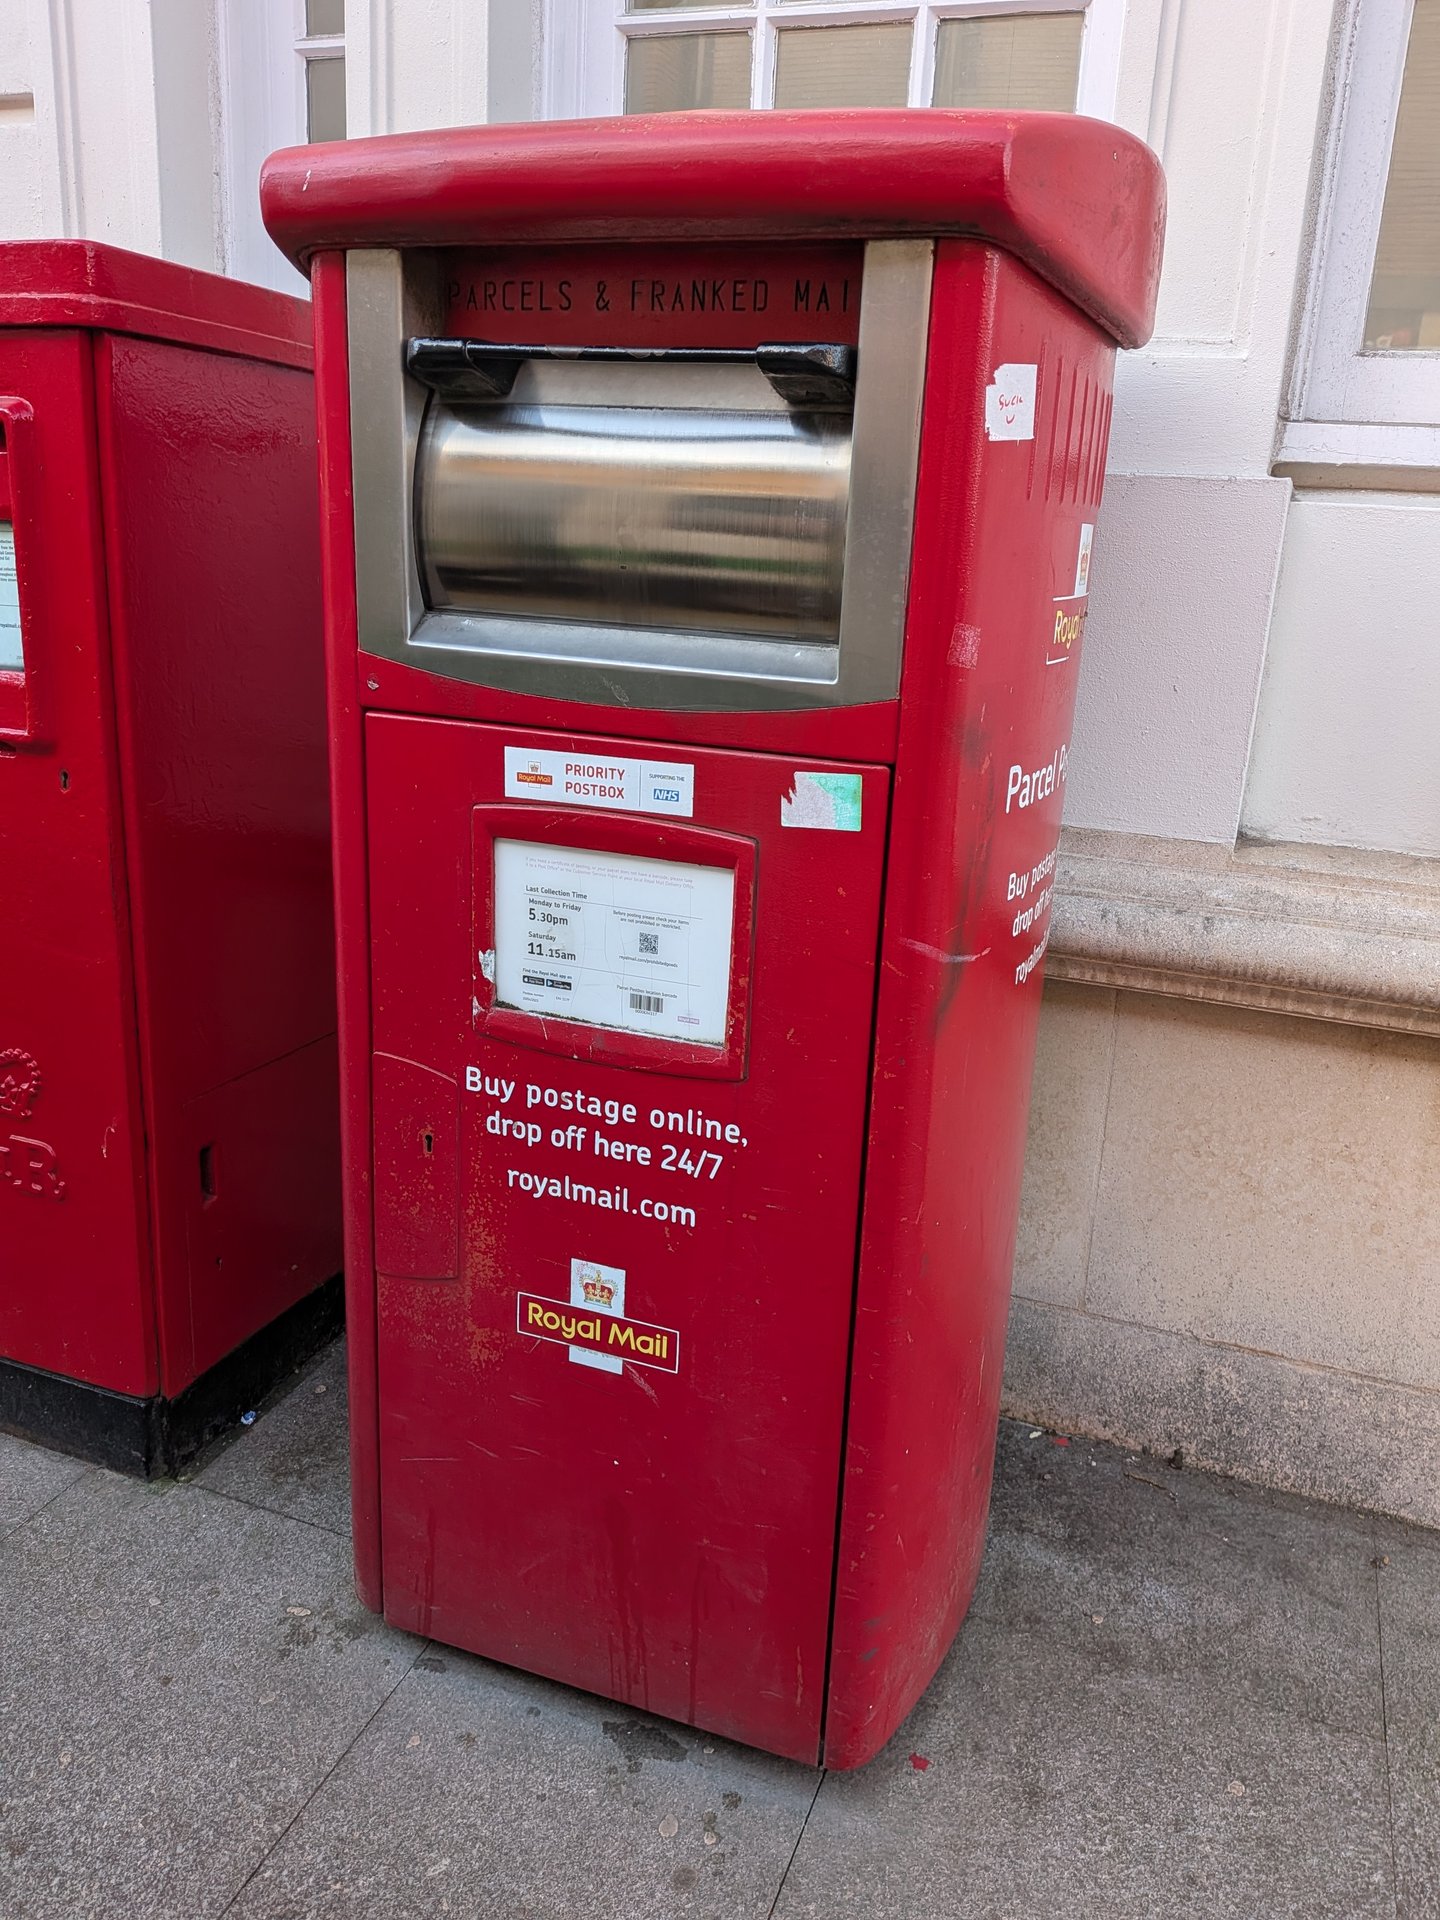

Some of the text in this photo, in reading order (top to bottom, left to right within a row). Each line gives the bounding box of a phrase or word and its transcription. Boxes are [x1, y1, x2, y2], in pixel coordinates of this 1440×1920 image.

[447, 280, 572, 312] PARCELS
[595, 280, 611, 312] &
[630, 279, 770, 312] FRANKED
[519, 774, 536, 782] Royal
[565, 763, 625, 781] PRIORITY
[1006, 749, 1058, 814] Parcel
[565, 781, 625, 800] POSTBOX
[655, 790, 678, 800] NHS
[541, 887, 570, 897] Collection
[1007, 873, 1030, 901] Buy
[529, 898, 552, 908] Monday
[563, 903, 581, 912] Friday
[529, 908, 568, 925] 5.30pm
[1012, 907, 1033, 937] drop
[528, 931, 556, 942] Saturday
[528, 942, 576, 961] 11.15am
[466, 1066, 748, 1148] Buy postage online,
[486, 1111, 723, 1180] drop off here 24/7
[507, 1169, 696, 1228] royalmail.com
[528, 1302, 668, 1358] Royal Mail
